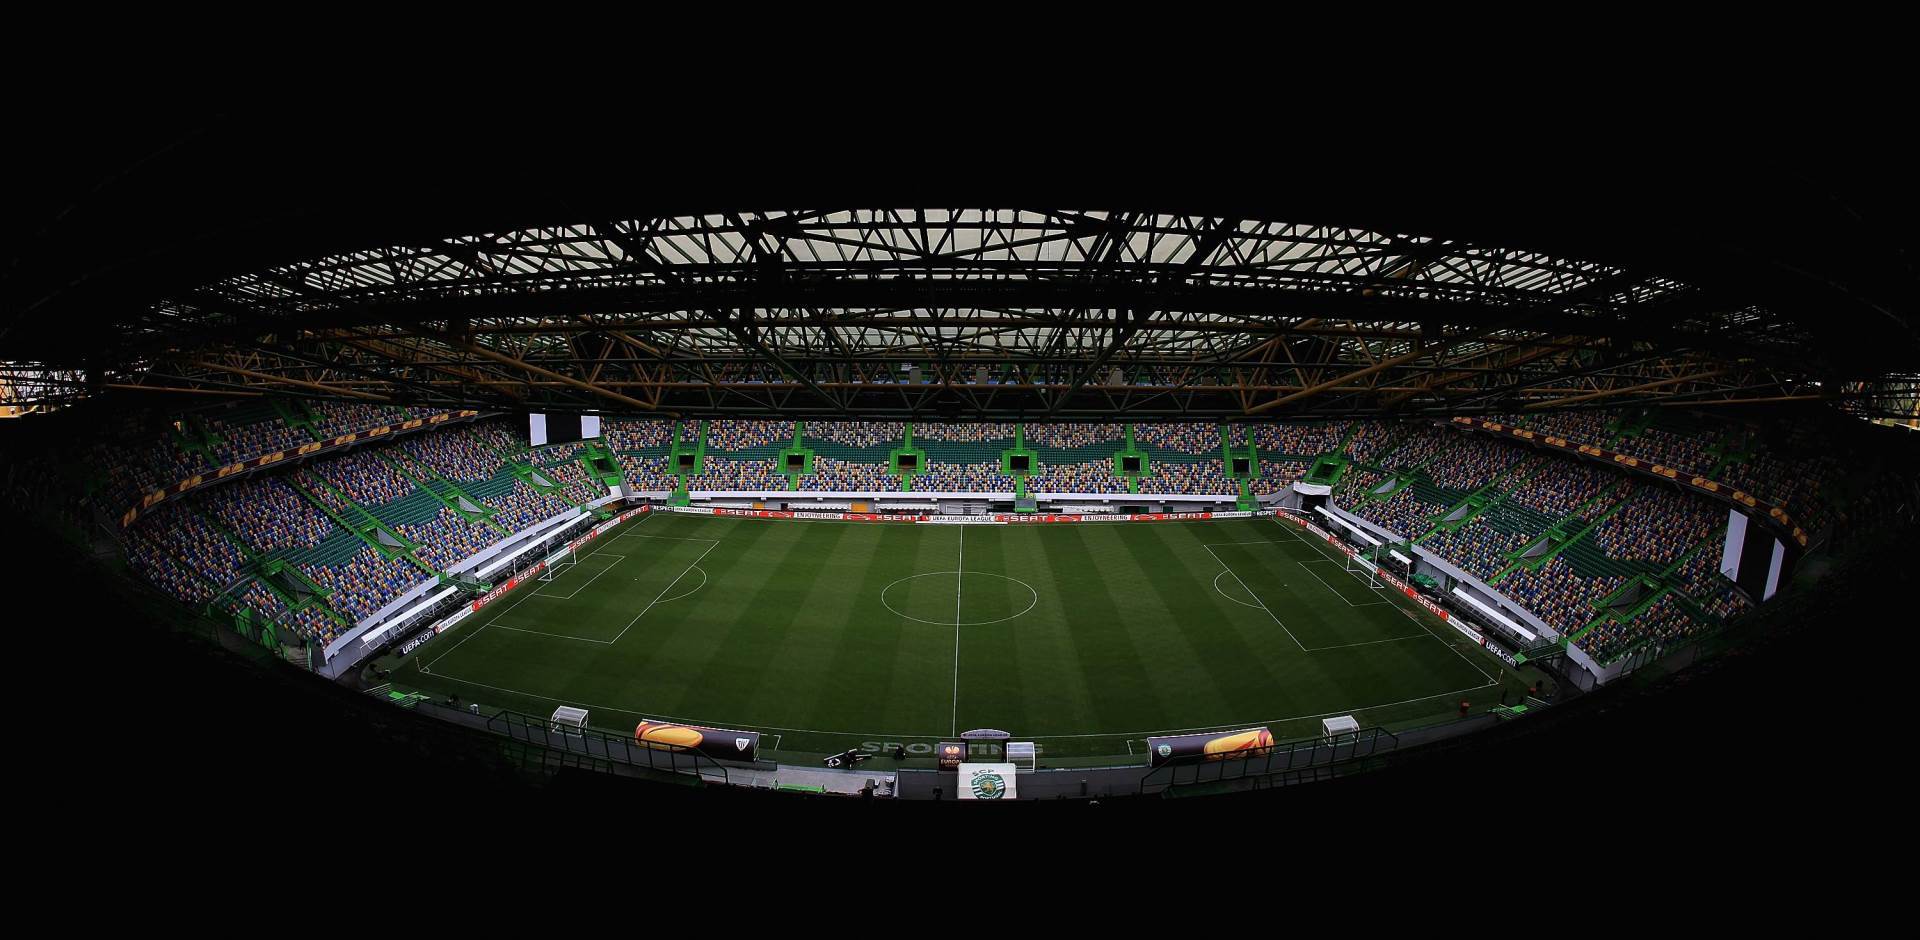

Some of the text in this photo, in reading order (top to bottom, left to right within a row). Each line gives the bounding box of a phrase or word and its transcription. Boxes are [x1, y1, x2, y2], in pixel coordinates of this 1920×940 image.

[625, 505, 646, 519] SEAT
[725, 509, 762, 517] SEAT
[1170, 512, 1206, 520] SEAT
[1284, 511, 1304, 526] SEAT
[576, 531, 595, 547] SEAT
[1385, 572, 1408, 594] SEAT
[482, 583, 509, 606] SEAT
[1416, 594, 1445, 617] SEAT
